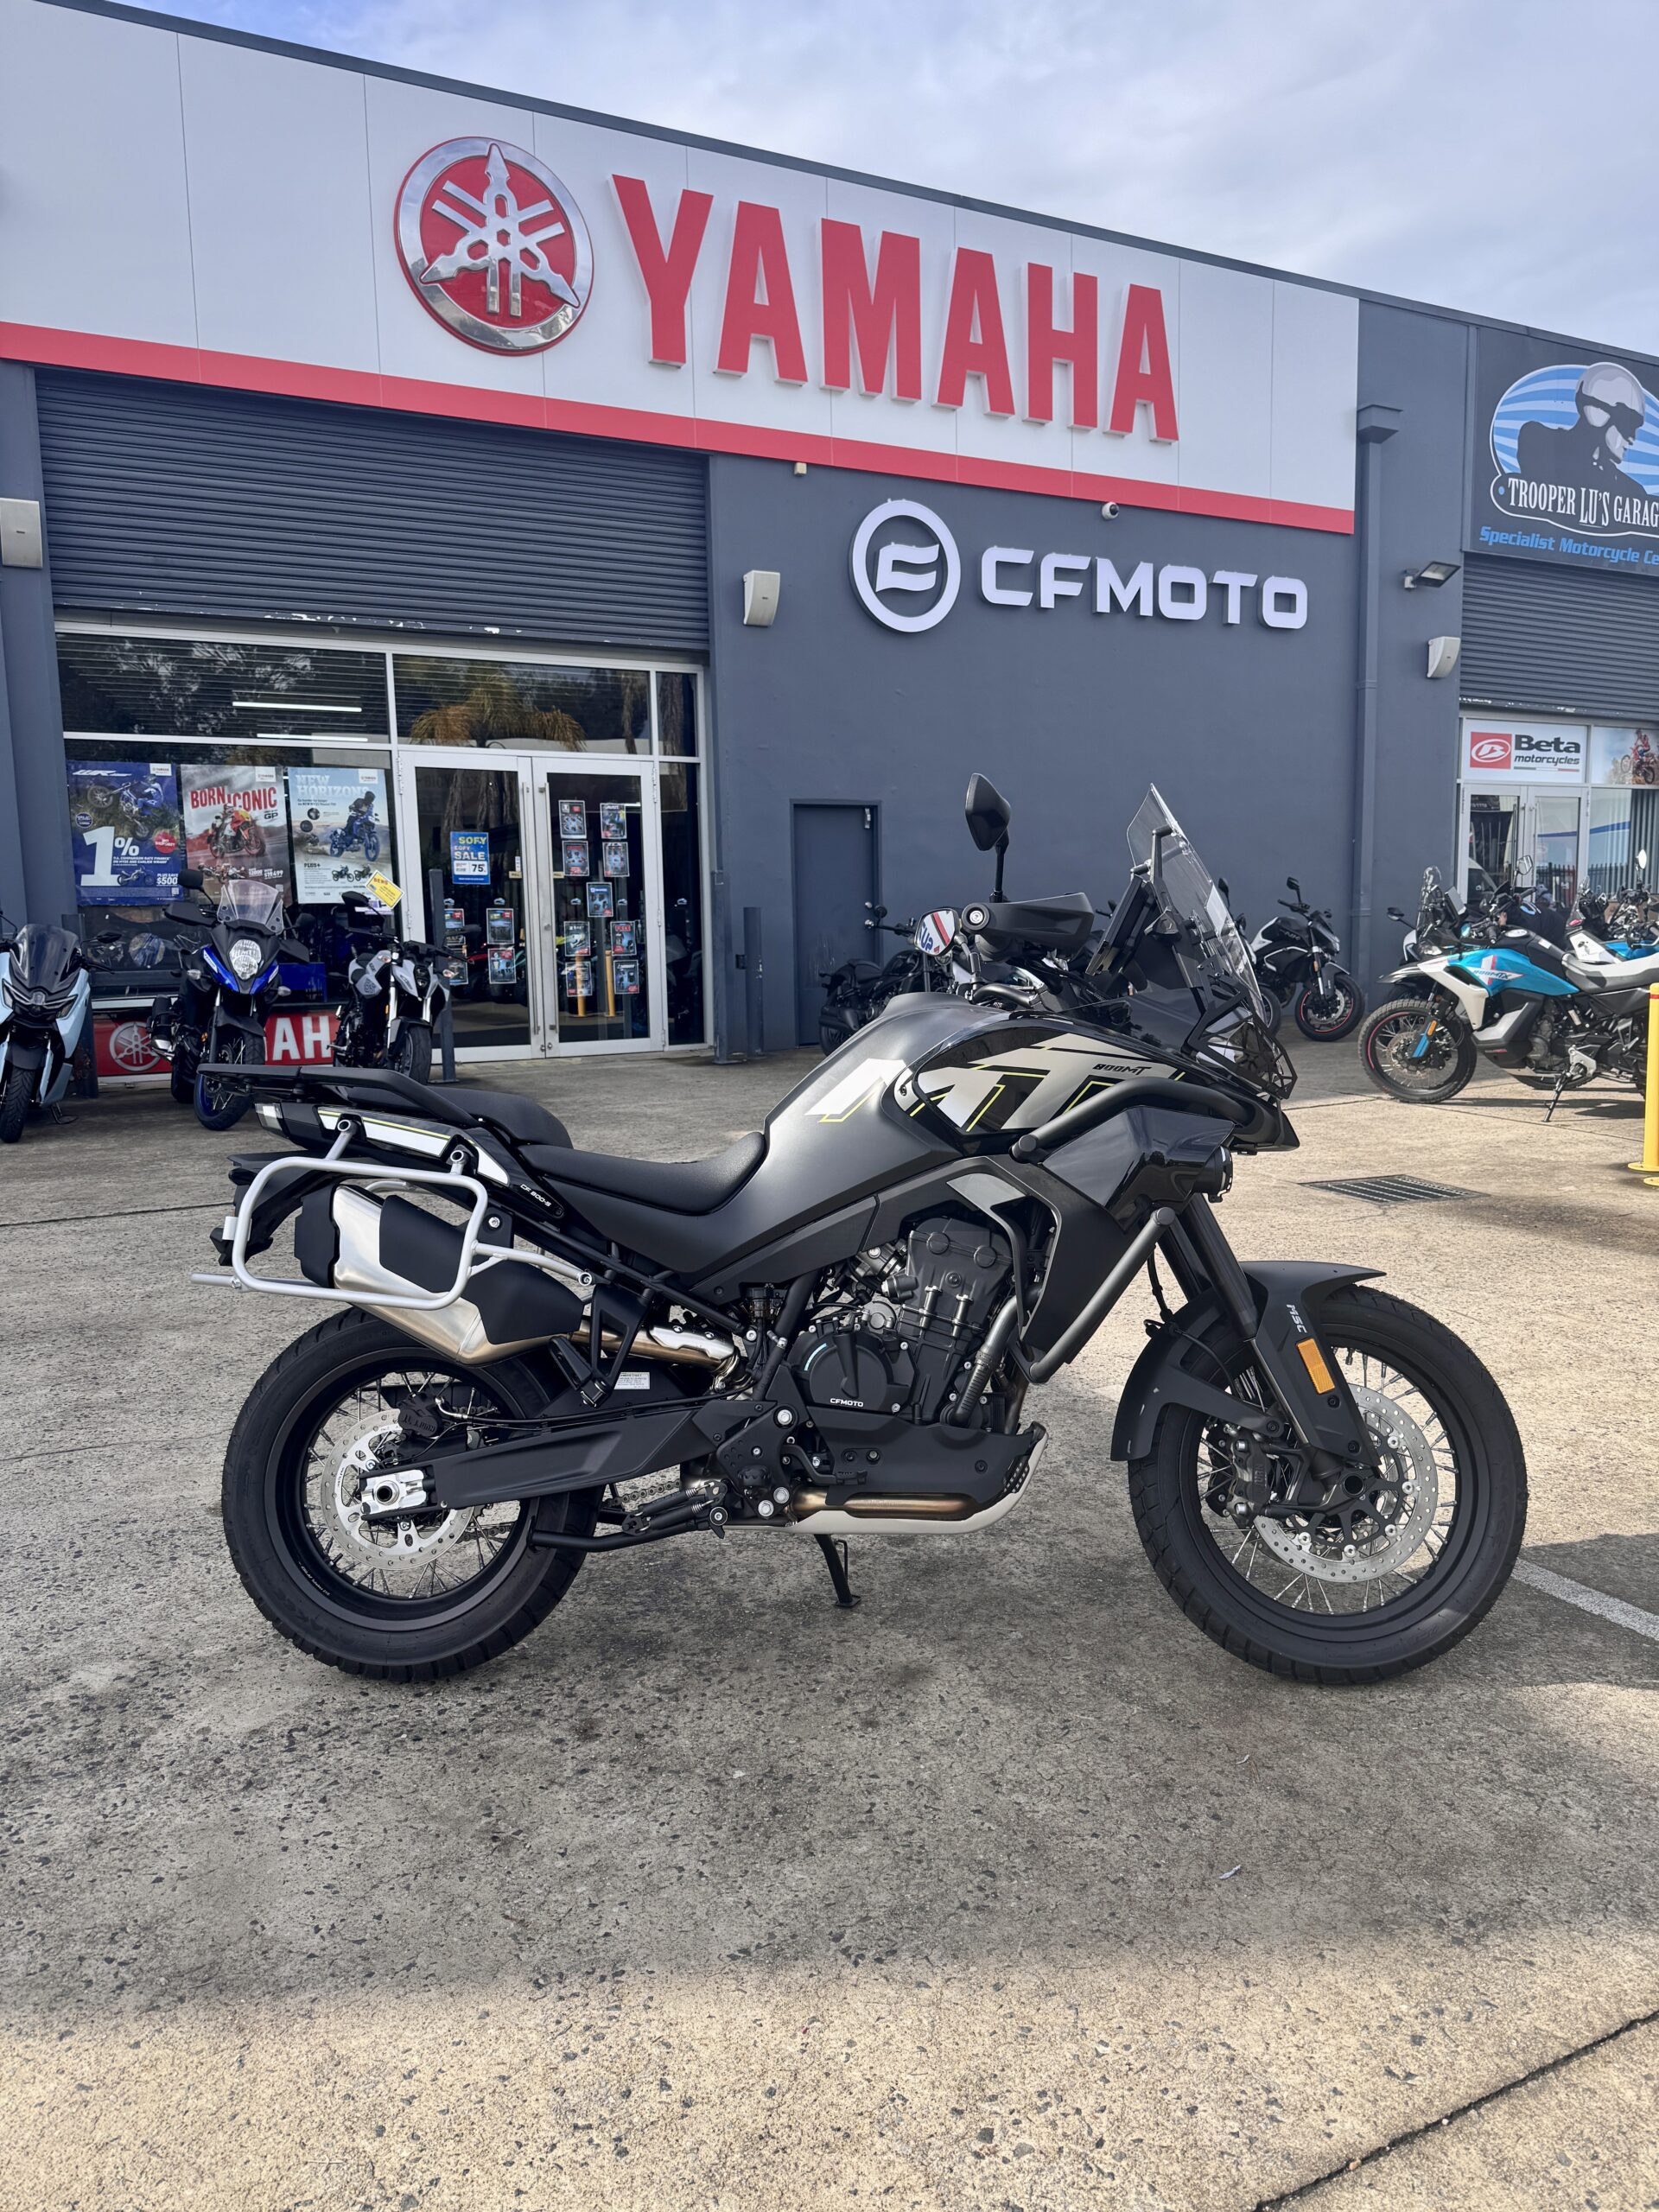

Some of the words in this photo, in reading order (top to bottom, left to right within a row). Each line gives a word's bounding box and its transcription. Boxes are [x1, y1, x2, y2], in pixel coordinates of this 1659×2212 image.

[611, 173, 1179, 445] YAMAHA
[1508, 477, 1576, 516] TROOPER
[1579, 487, 1610, 527] LU'S
[1478, 525, 1555, 550] Specialist
[1559, 537, 1640, 563] Motorcycle
[981, 544, 1308, 630] CFMOTO
[1514, 734, 1581, 753] Beta
[1514, 754, 1580, 766] motorcycles
[296, 774, 330, 785] NEW
[190, 785, 226, 809] BORN
[227, 786, 278, 812] ICONIC
[454, 851, 486, 861] SALE
[519, 1184, 531, 1192] CF
[1286, 1304, 1308, 1333] MSC
[830, 1397, 864, 1408] CFMOTO
